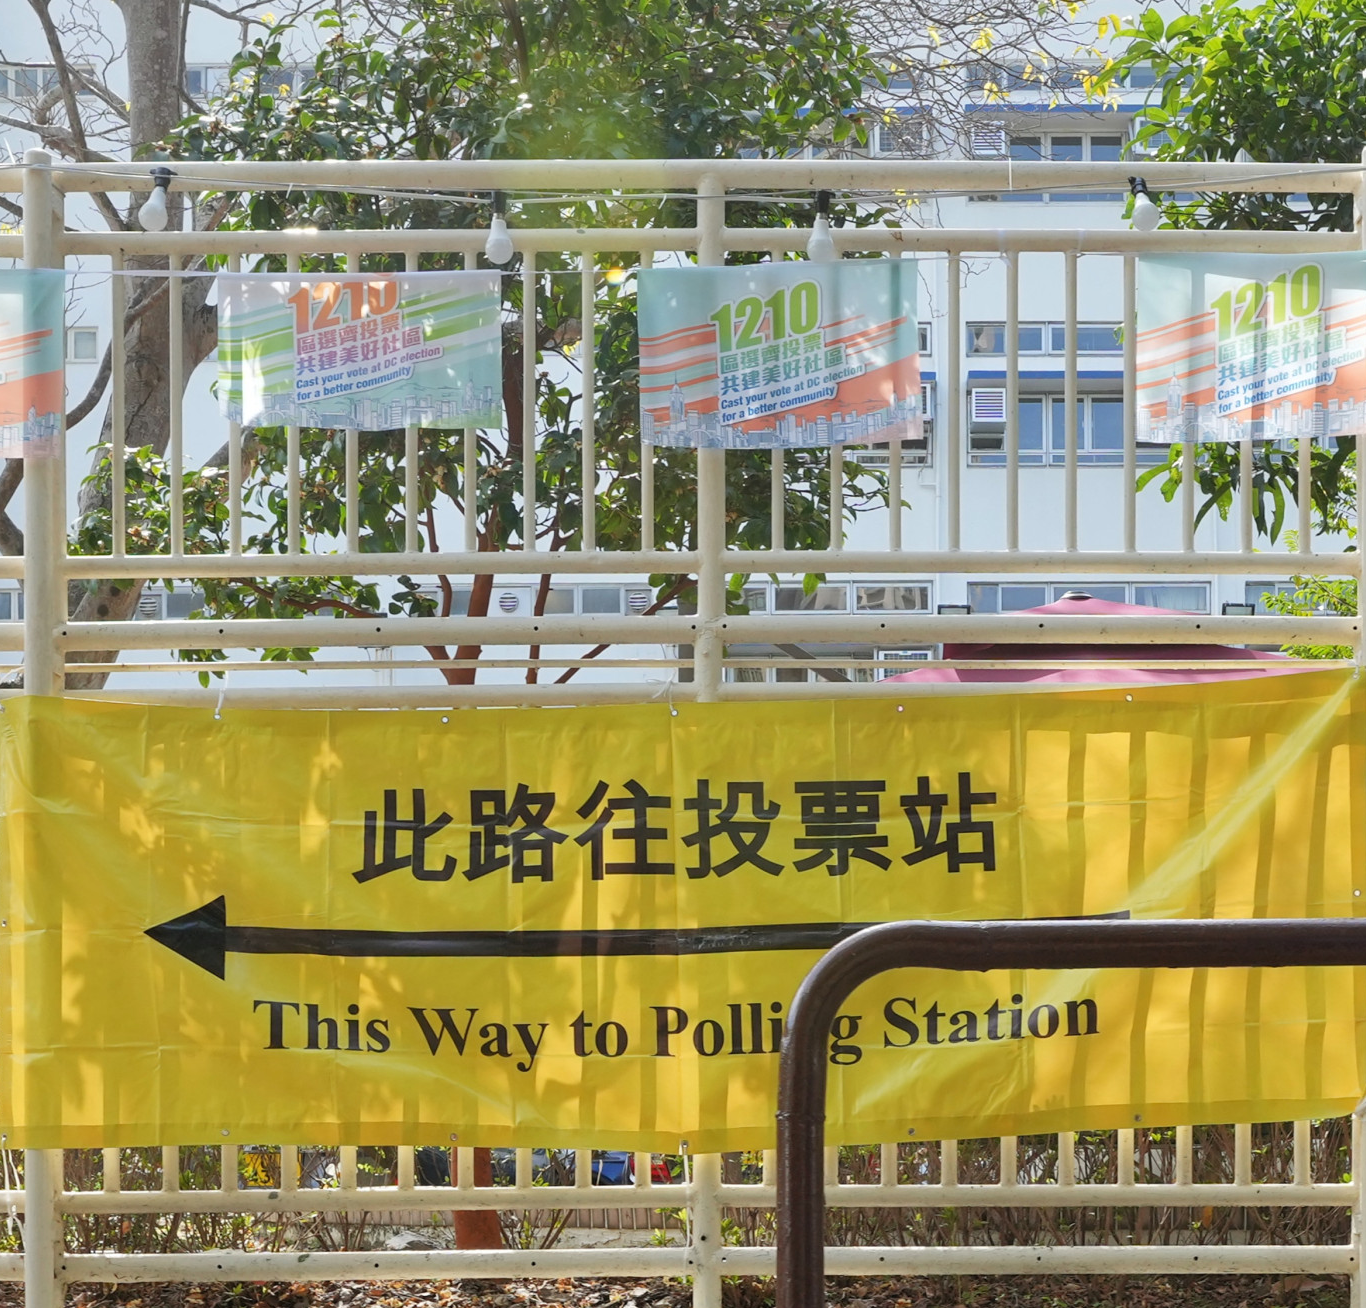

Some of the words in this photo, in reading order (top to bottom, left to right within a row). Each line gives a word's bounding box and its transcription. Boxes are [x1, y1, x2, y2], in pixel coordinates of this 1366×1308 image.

[710, 282, 819, 353] 1210
[1211, 265, 1320, 342] 1210
[297, 312, 400, 356] 區選齊投票
[297, 326, 421, 375] 共建美好社區
[721, 332, 821, 374] 區選齊投票
[1218, 314, 1322, 364] 區選齊投票
[1218, 330, 1345, 386] 共建美好社區
[297, 377, 318, 388] Cast
[321, 372, 344, 385] your
[347, 367, 368, 377] vote
[371, 364, 381, 372] at
[385, 358, 397, 368] DC
[400, 347, 440, 363] election
[297, 390, 310, 400] for
[323, 383, 353, 396] better
[356, 366, 411, 389] community
[721, 346, 843, 395] 共建美好社區
[721, 397, 743, 409] Cast
[746, 393, 767, 406] your
[770, 387, 791, 398] vote
[794, 383, 804, 392] at
[807, 377, 820, 388] DC
[823, 364, 863, 383] election
[1218, 387, 1240, 400] Cast
[1243, 379, 1265, 394] your
[1267, 373, 1289, 385] vote
[1292, 368, 1302, 377] at
[1305, 362, 1319, 373] DC
[1322, 349, 1362, 368] election
[1218, 403, 1232, 413] for
[1244, 391, 1273, 405] better
[1277, 371, 1334, 395] community
[722, 412, 736, 422] for
[748, 403, 777, 416] better
[780, 386, 835, 408] community
[352, 772, 997, 884] 此路往投票站
[253, 1000, 391, 1053] This
[407, 1006, 549, 1072] Way
[569, 1010, 628, 1058] to
[649, 1001, 862, 1065] Pollig
[884, 994, 1099, 1048] Station
